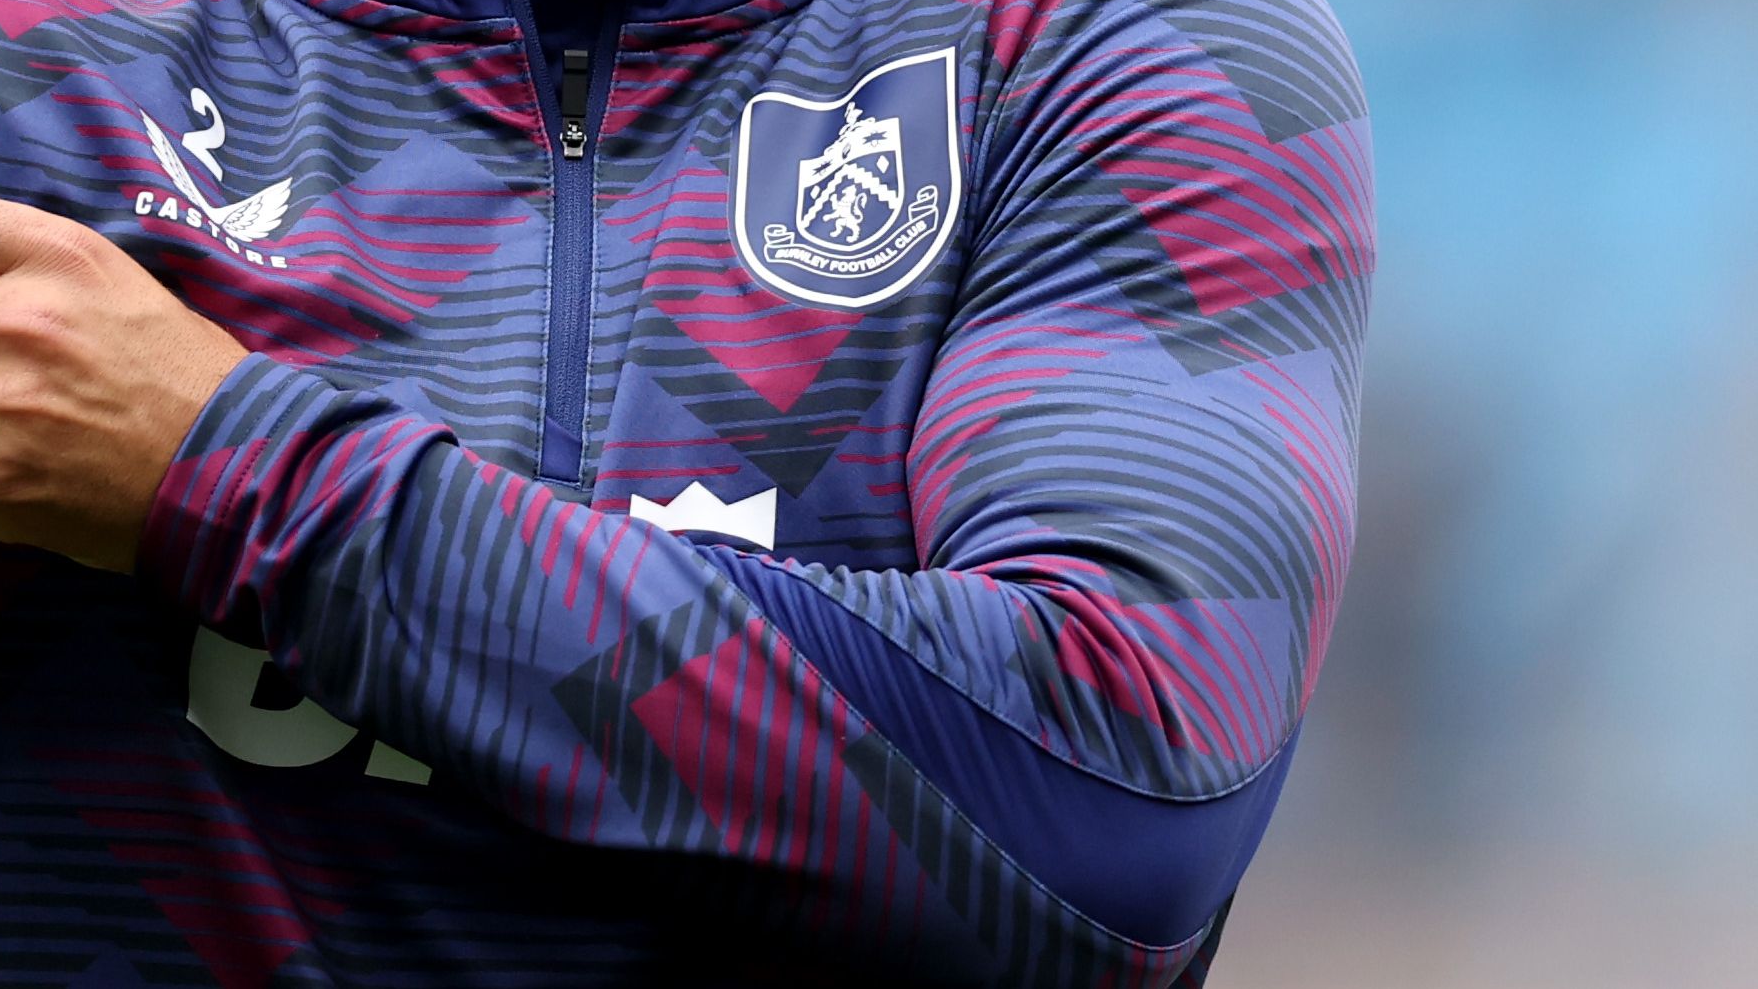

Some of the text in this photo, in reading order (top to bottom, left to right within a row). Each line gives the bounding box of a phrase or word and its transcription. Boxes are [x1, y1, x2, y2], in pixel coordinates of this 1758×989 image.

[180, 87, 226, 182] 2
[135, 192, 288, 269] CASTORE
[774, 220, 928, 272] BURNLEY FOOTBALL CLUB
